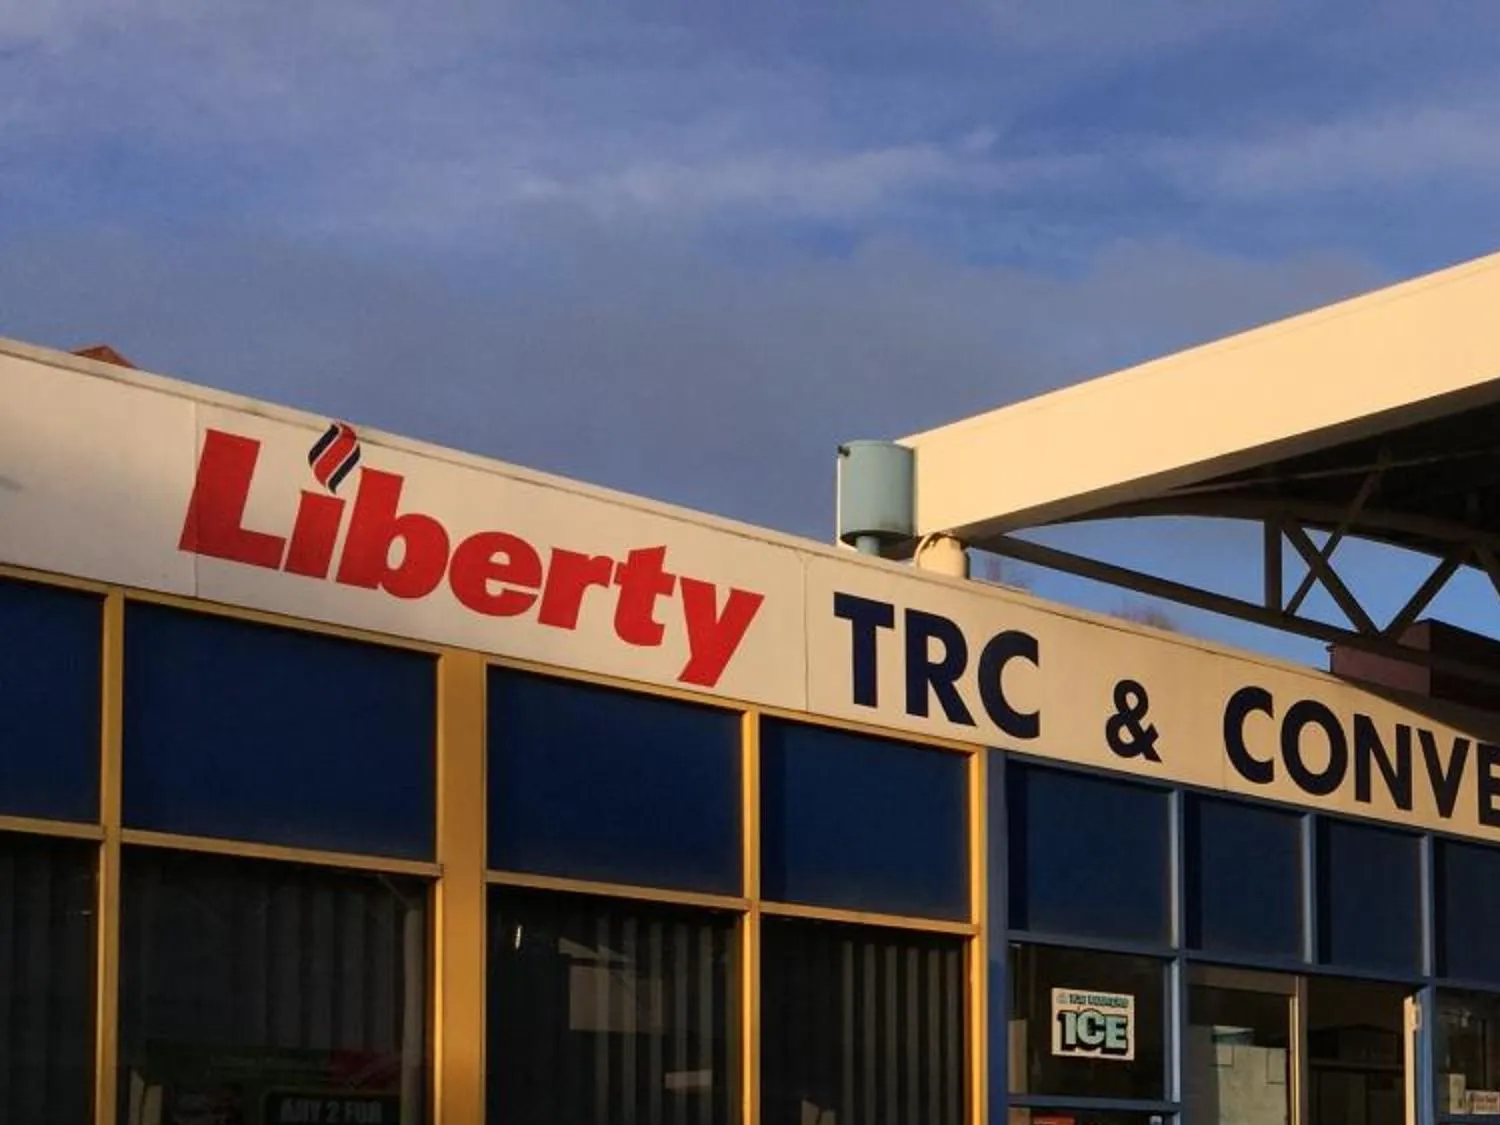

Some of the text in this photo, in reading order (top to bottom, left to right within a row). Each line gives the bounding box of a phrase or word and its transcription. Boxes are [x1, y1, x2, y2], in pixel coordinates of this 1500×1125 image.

[179, 422, 765, 688] Liberty
[833, 591, 1041, 740] TRC
[1104, 679, 1163, 764] &
[1057, 1009, 1128, 1056] ICE
